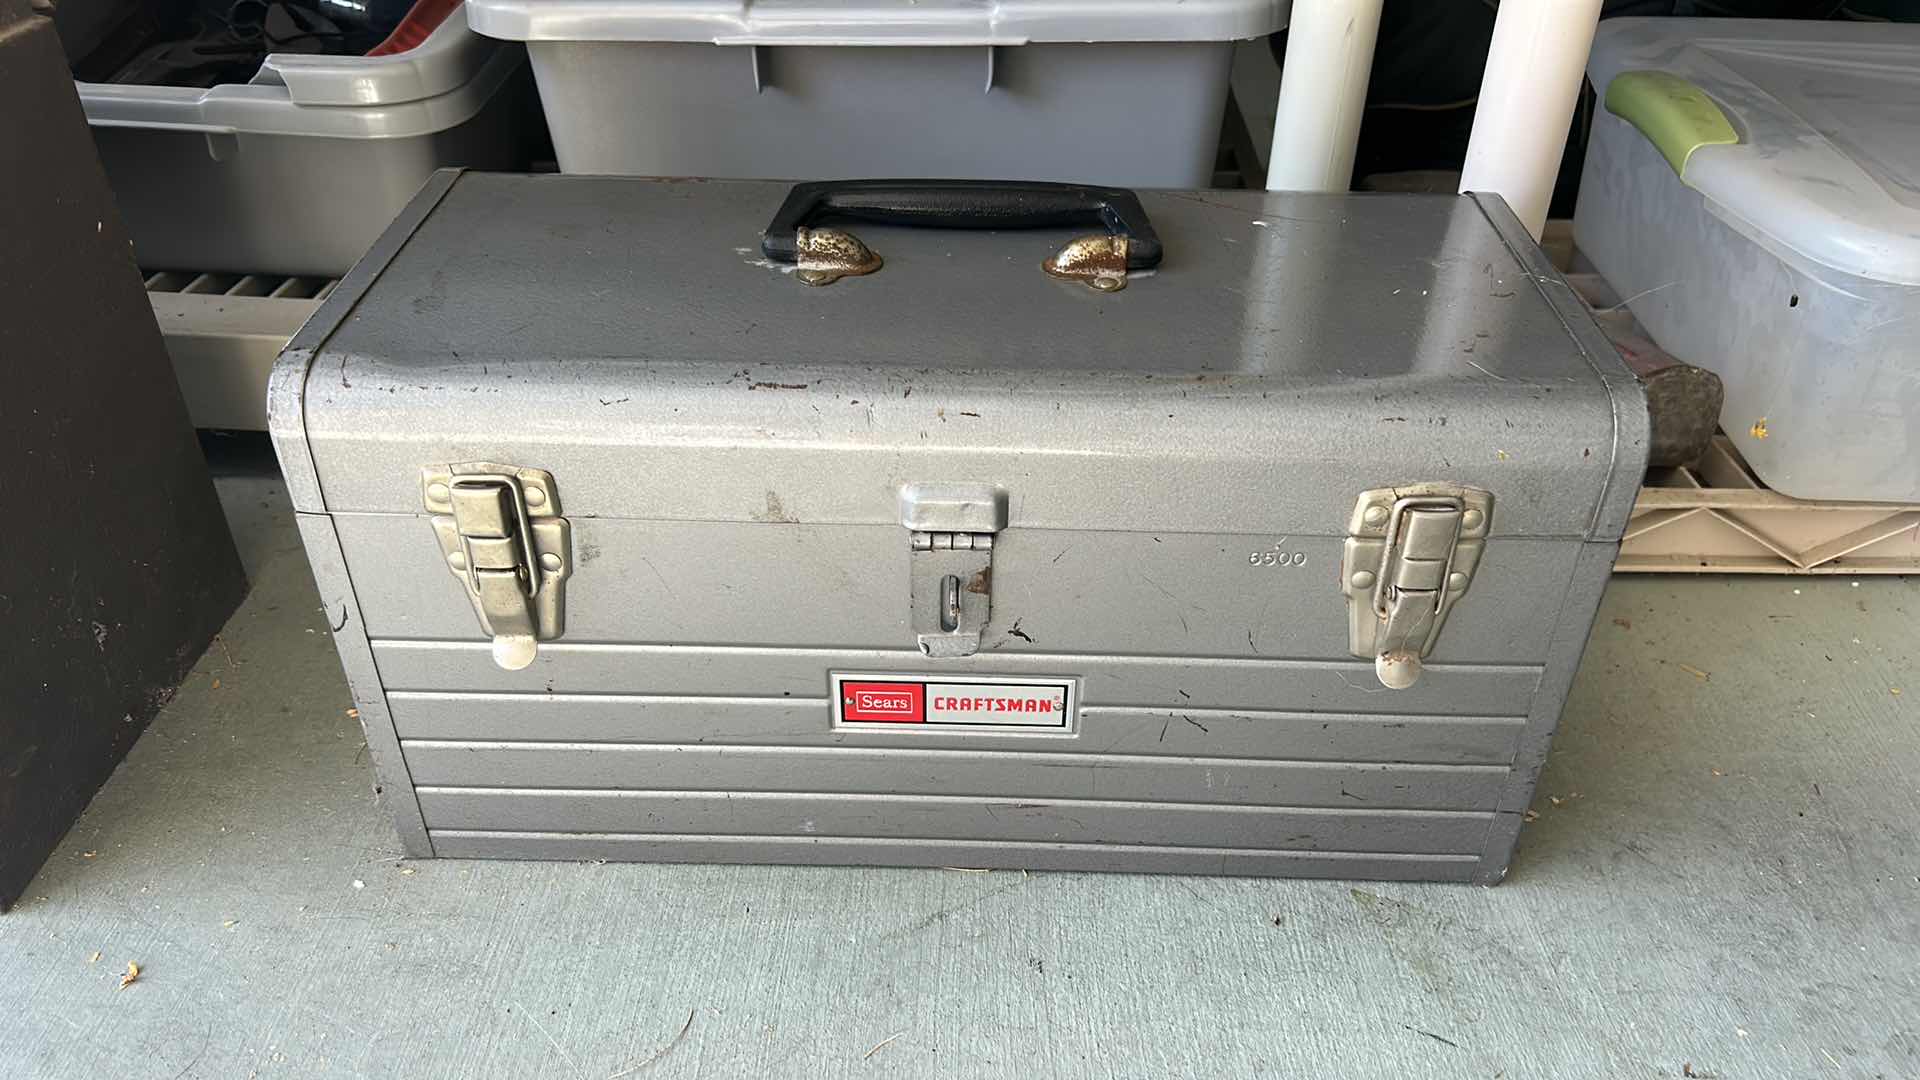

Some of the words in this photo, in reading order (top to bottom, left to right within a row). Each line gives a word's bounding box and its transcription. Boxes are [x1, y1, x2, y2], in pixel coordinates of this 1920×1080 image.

[1249, 552, 1307, 567] 6500
[861, 695, 909, 710] Sears
[933, 697, 1052, 713] CRAFTSMAN
